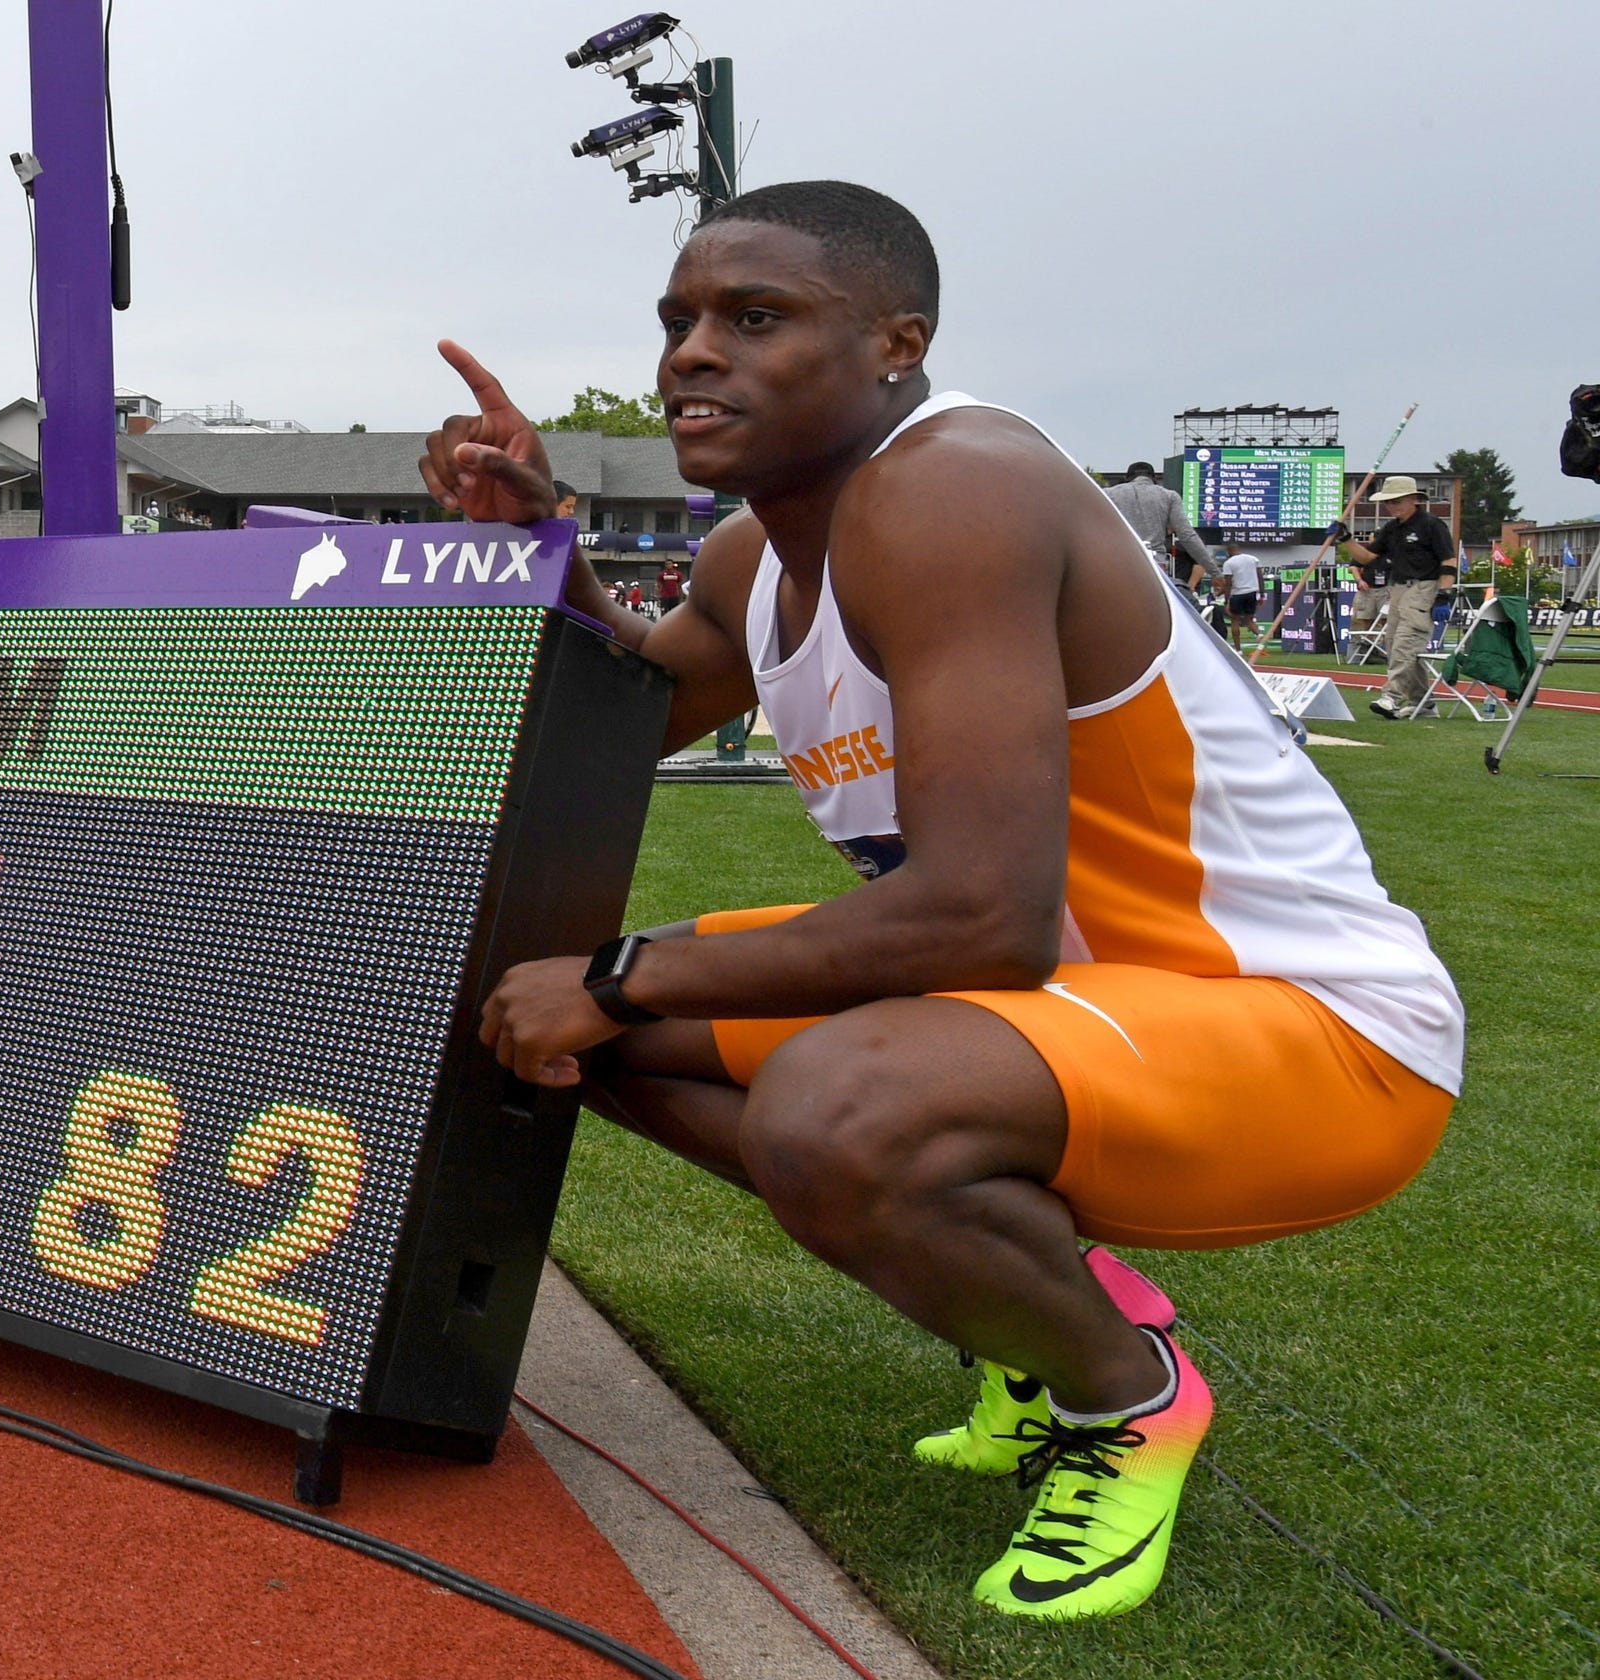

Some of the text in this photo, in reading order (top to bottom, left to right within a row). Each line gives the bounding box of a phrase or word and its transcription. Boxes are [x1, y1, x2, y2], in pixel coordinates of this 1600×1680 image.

[619, 19, 643, 34] LYNX
[622, 117, 647, 130] LYNX
[380, 539, 542, 584] LYNX
[1536, 609, 1588, 625] FIED
